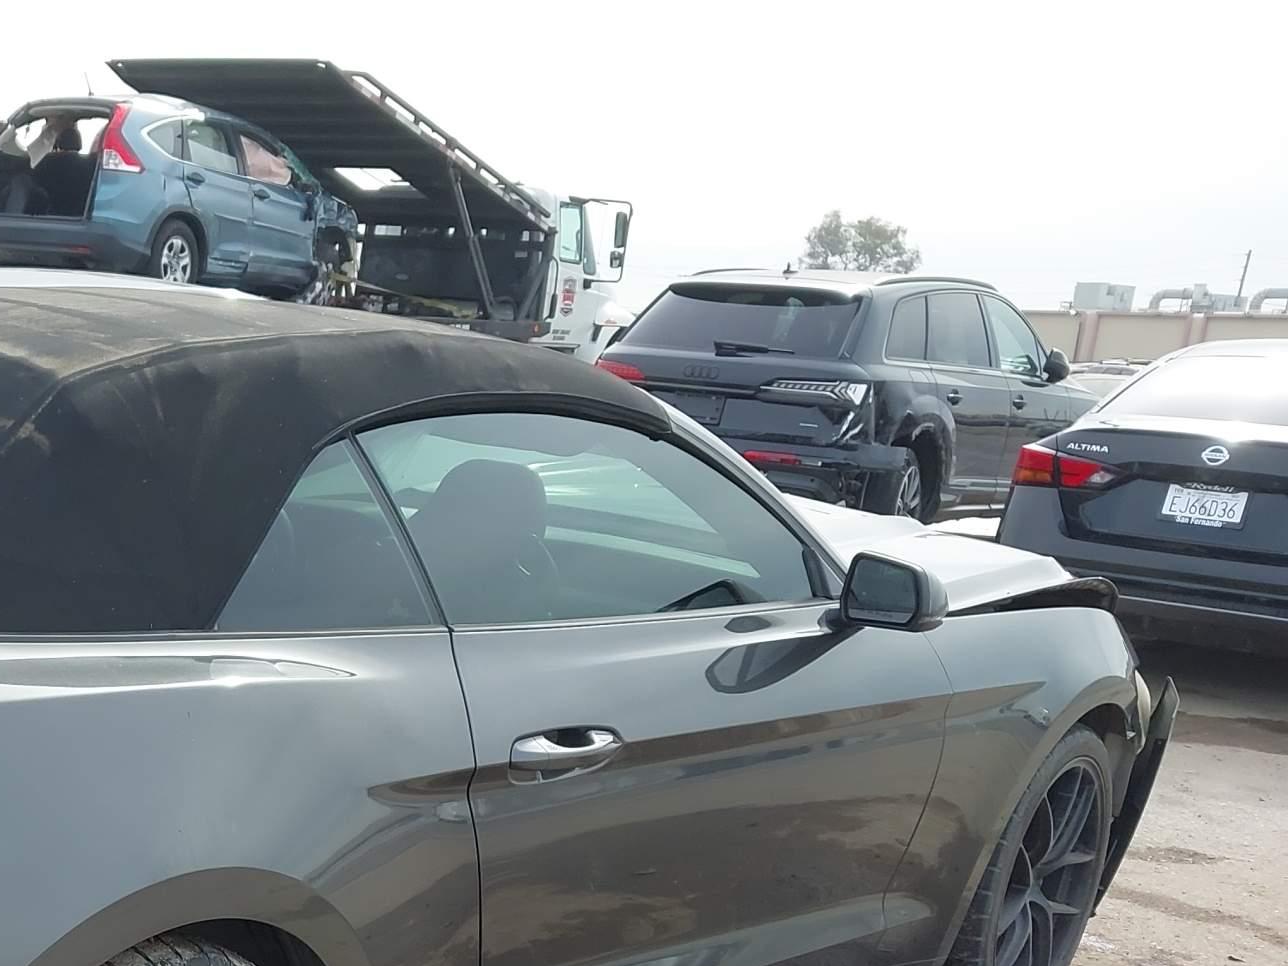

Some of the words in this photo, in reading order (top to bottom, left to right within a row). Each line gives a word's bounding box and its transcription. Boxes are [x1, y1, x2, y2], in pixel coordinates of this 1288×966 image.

[1066, 442, 1109, 453] ALTIMA
[1168, 495, 1239, 519] EJ66D36
[1175, 515, 1189, 524] San
[1189, 516, 1223, 528] Fernando
